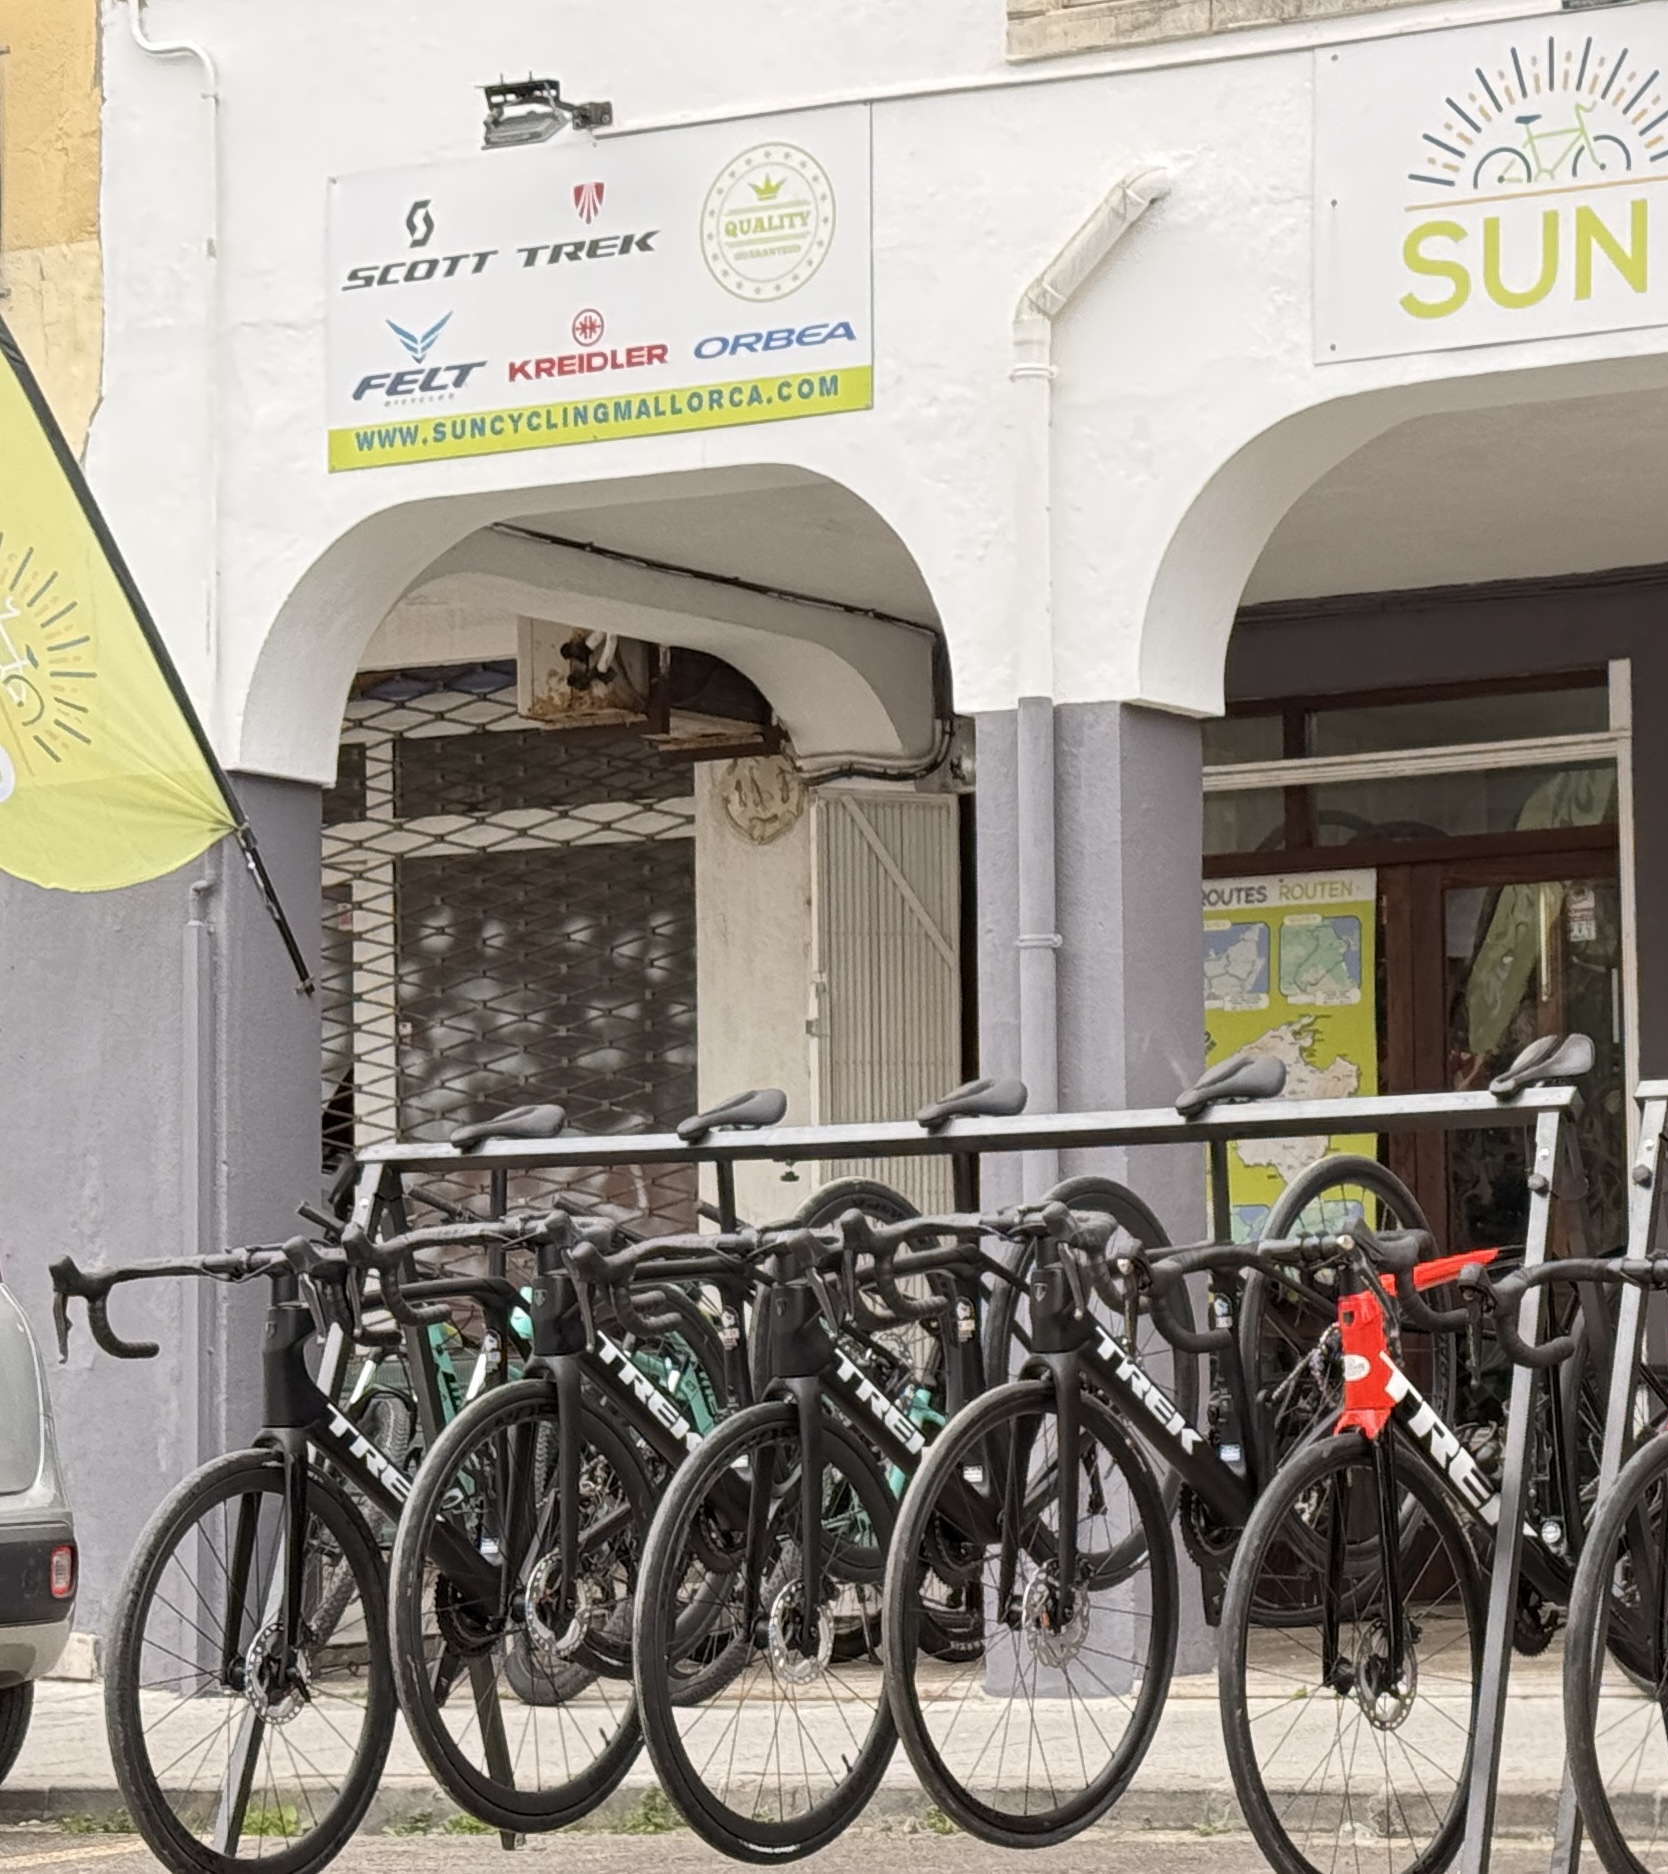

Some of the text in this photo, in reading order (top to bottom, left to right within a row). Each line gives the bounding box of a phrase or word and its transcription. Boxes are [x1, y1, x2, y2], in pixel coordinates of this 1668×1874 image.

[725, 210, 811, 238] QUALITY
[341, 229, 662, 291] SCOTT TREK
[1399, 197, 1649, 320] SUN
[508, 342, 669, 383] KREIDLER
[694, 321, 857, 360] ORBEA
[352, 360, 488, 402] FELT
[355, 374, 840, 452] WWW.SUNCYCLINGMALLORCA.COM
[1279, 880, 1353, 901] ROUTEN
[1096, 1325, 1203, 1456] TREK
[327, 1402, 415, 1503] TRE
